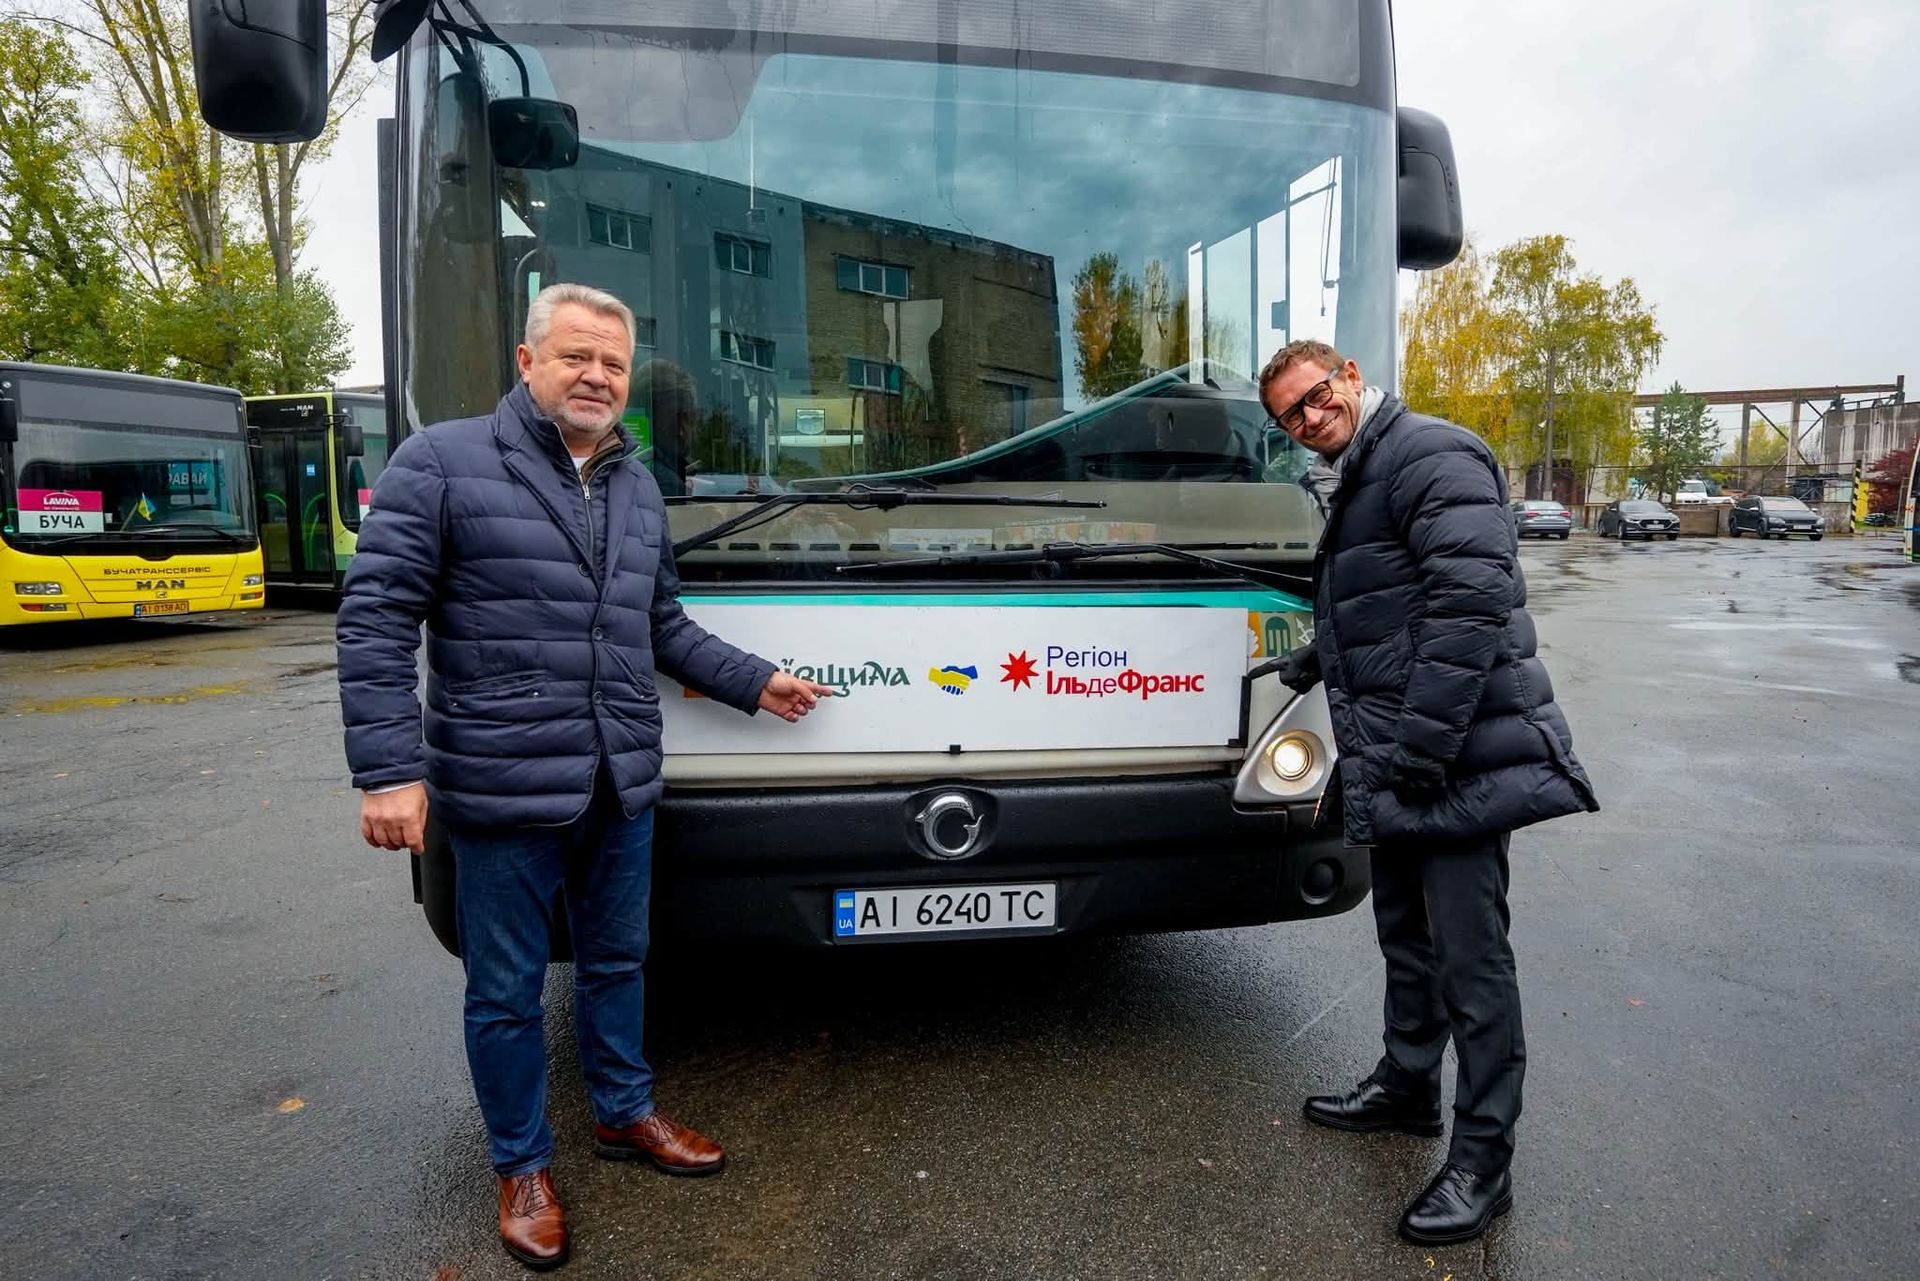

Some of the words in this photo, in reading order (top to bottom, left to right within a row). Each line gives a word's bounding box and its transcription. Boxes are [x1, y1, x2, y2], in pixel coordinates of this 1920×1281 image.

[43, 497, 80, 506] LAVINA
[39, 514, 85, 529] БУЧА
[103, 566, 211, 576] БУЧАТРАНССЕРВІС
[136, 579, 185, 591] MAN
[1046, 645, 1128, 668] Регіон
[1046, 668, 1206, 701] ІльдеФранс
[859, 895, 898, 929] AI
[916, 891, 992, 926] 6240
[999, 889, 1045, 922] TC
[838, 918, 854, 930] UA
